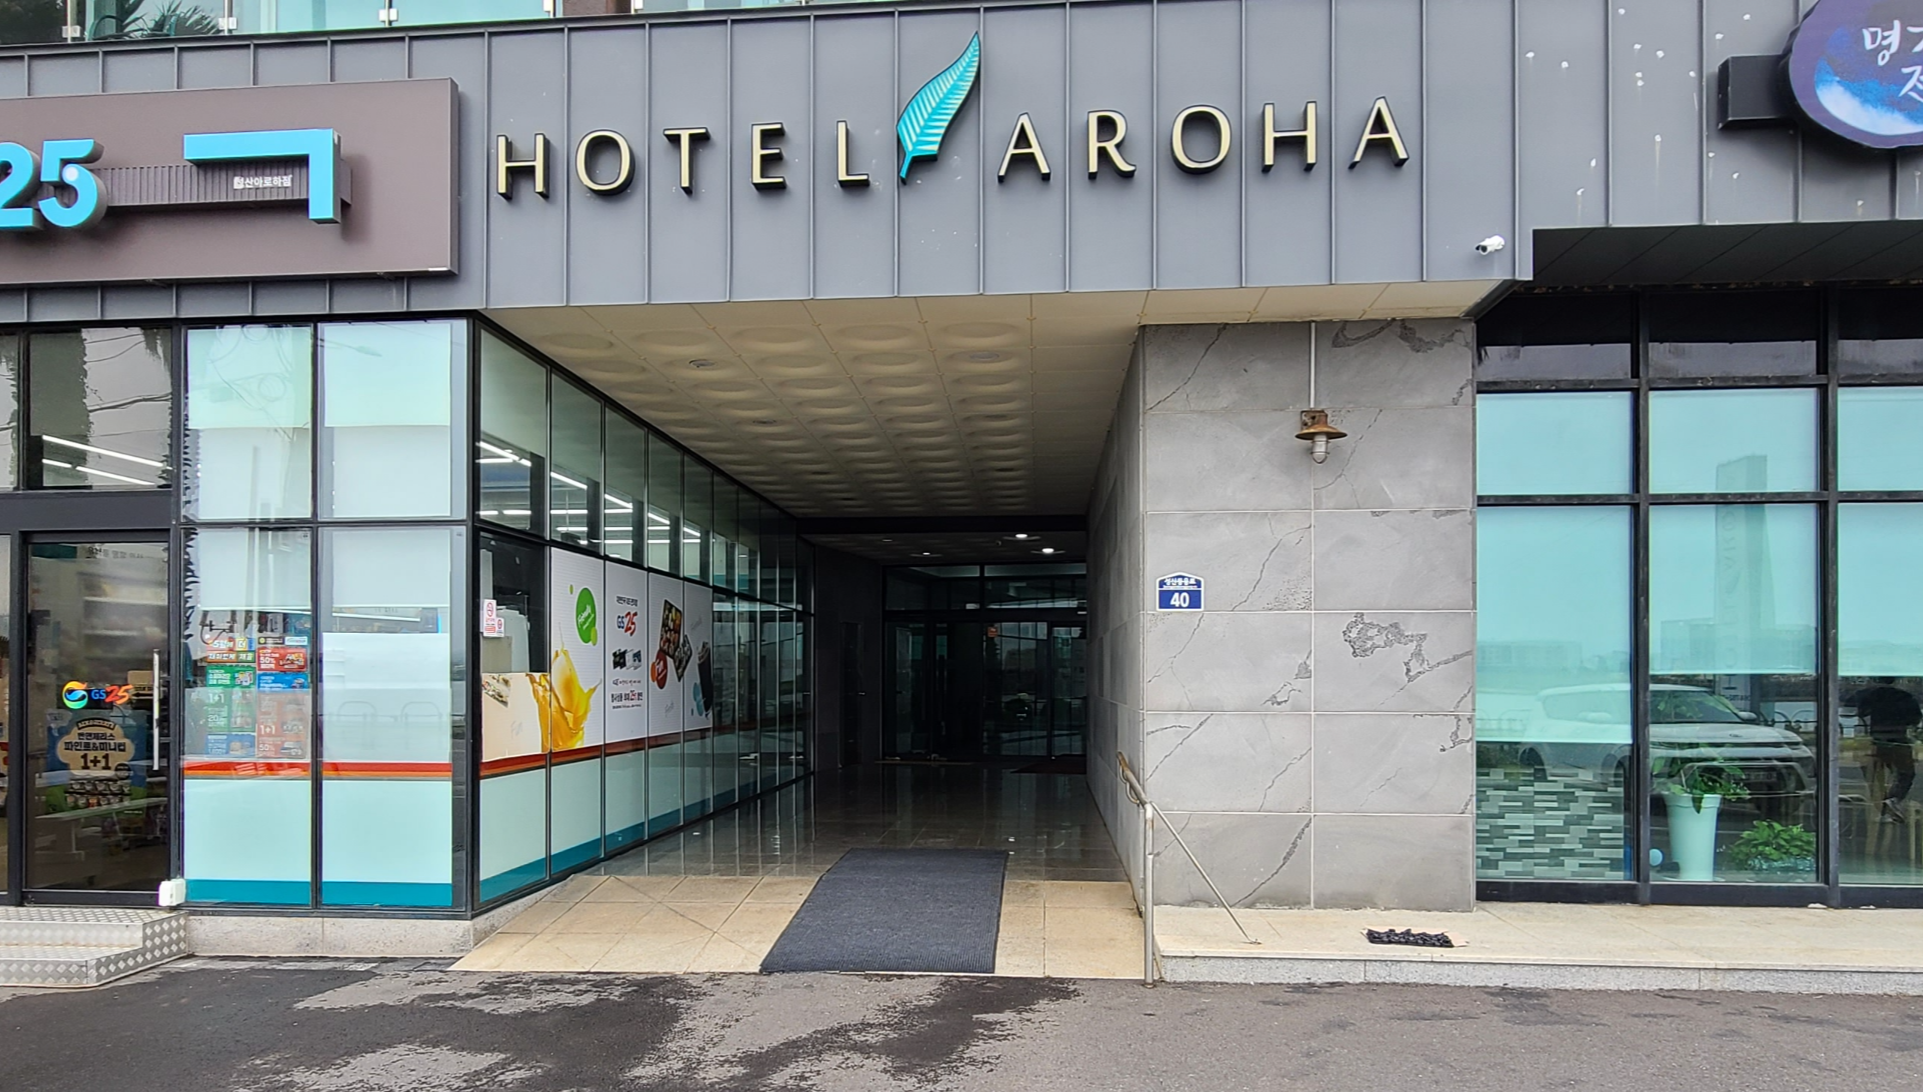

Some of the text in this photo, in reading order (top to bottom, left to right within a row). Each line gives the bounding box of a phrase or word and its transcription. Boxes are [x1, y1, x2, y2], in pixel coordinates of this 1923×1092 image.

[496, 96, 1409, 199] HOTEL AROHA
[0, 139, 100, 228] 25
[1170, 592, 1190, 607] 40
[617, 611, 638, 637] GS25
[91, 684, 133, 705] GS25
[208, 693, 225, 703] 1+1
[260, 725, 276, 734] 1+1
[81, 753, 111, 770] 1+1
